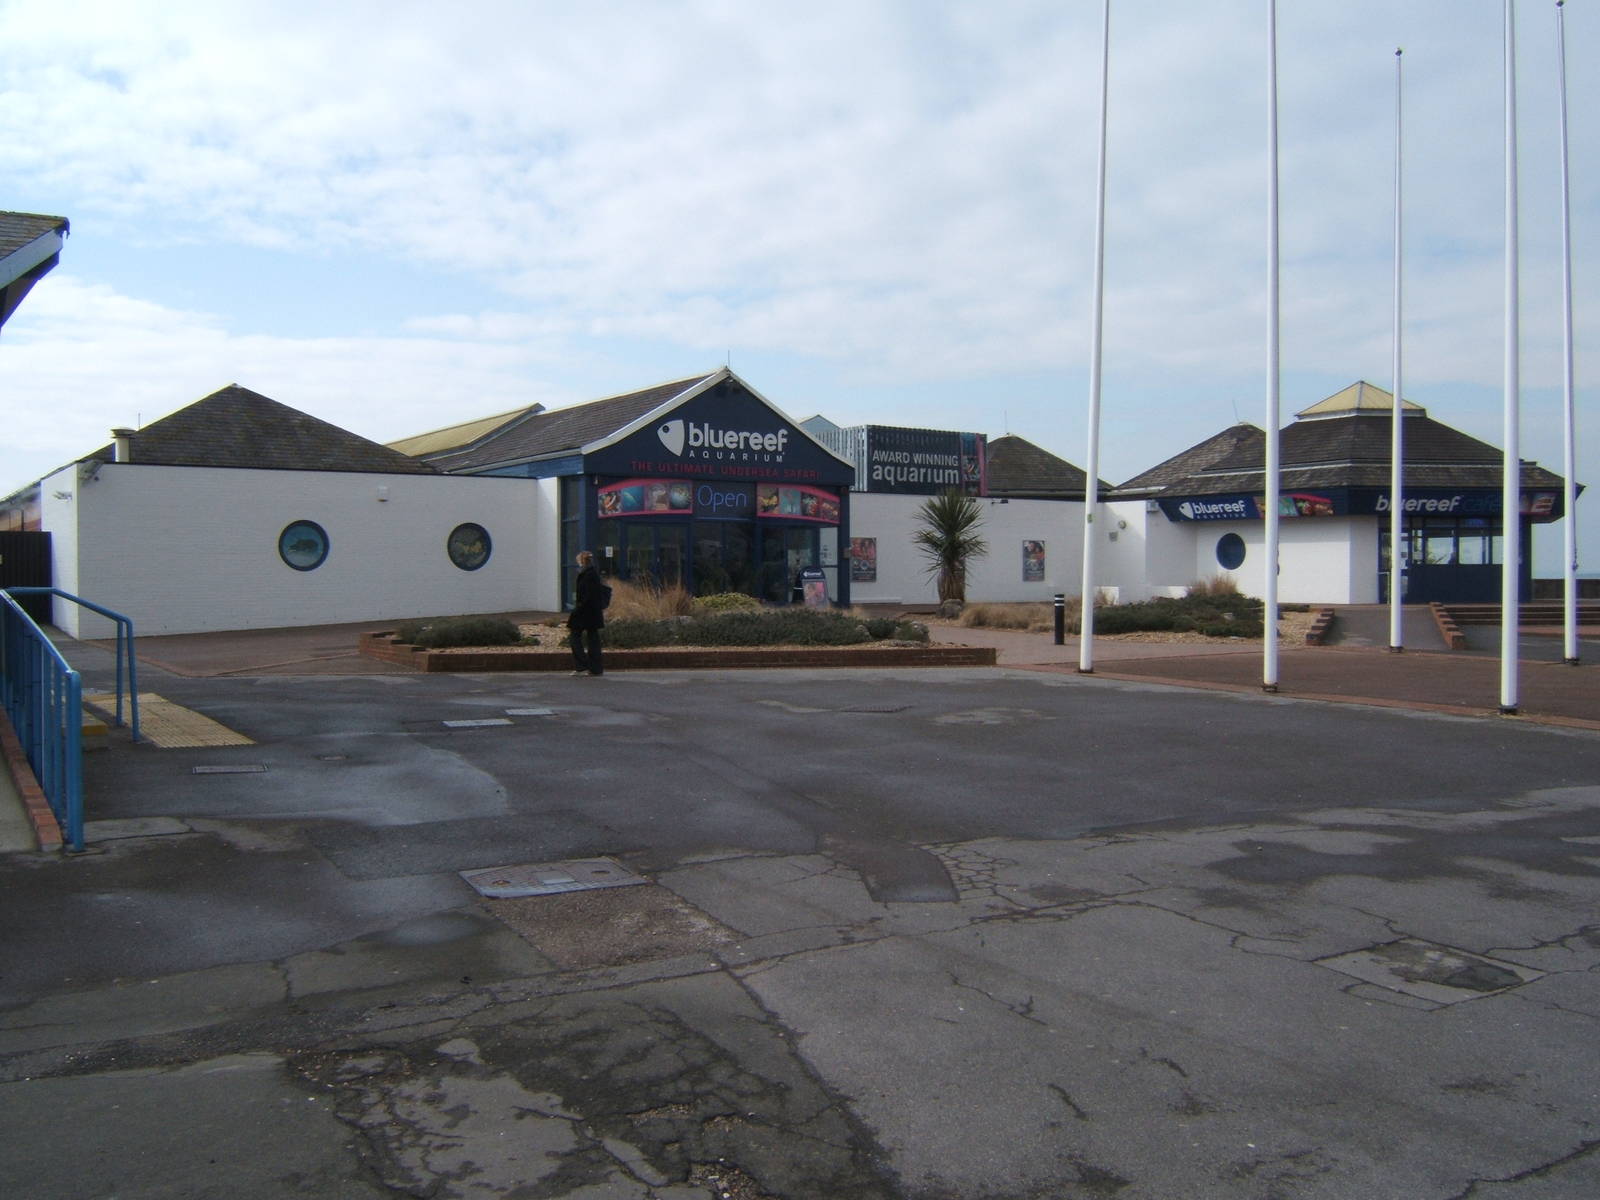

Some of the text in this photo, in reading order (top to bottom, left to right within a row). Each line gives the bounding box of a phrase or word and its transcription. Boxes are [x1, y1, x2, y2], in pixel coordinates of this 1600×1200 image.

[689, 422, 788, 451] bluereef
[689, 450, 783, 462] AQUARIUM
[872, 450, 959, 467] AWARD WINNING
[631, 461, 652, 472] THE
[658, 462, 715, 474] ULTIMATE
[720, 466, 778, 478] UNDERSEA
[872, 465, 960, 486] aquarium
[698, 485, 747, 512] Open
[1192, 500, 1246, 514] bluereef
